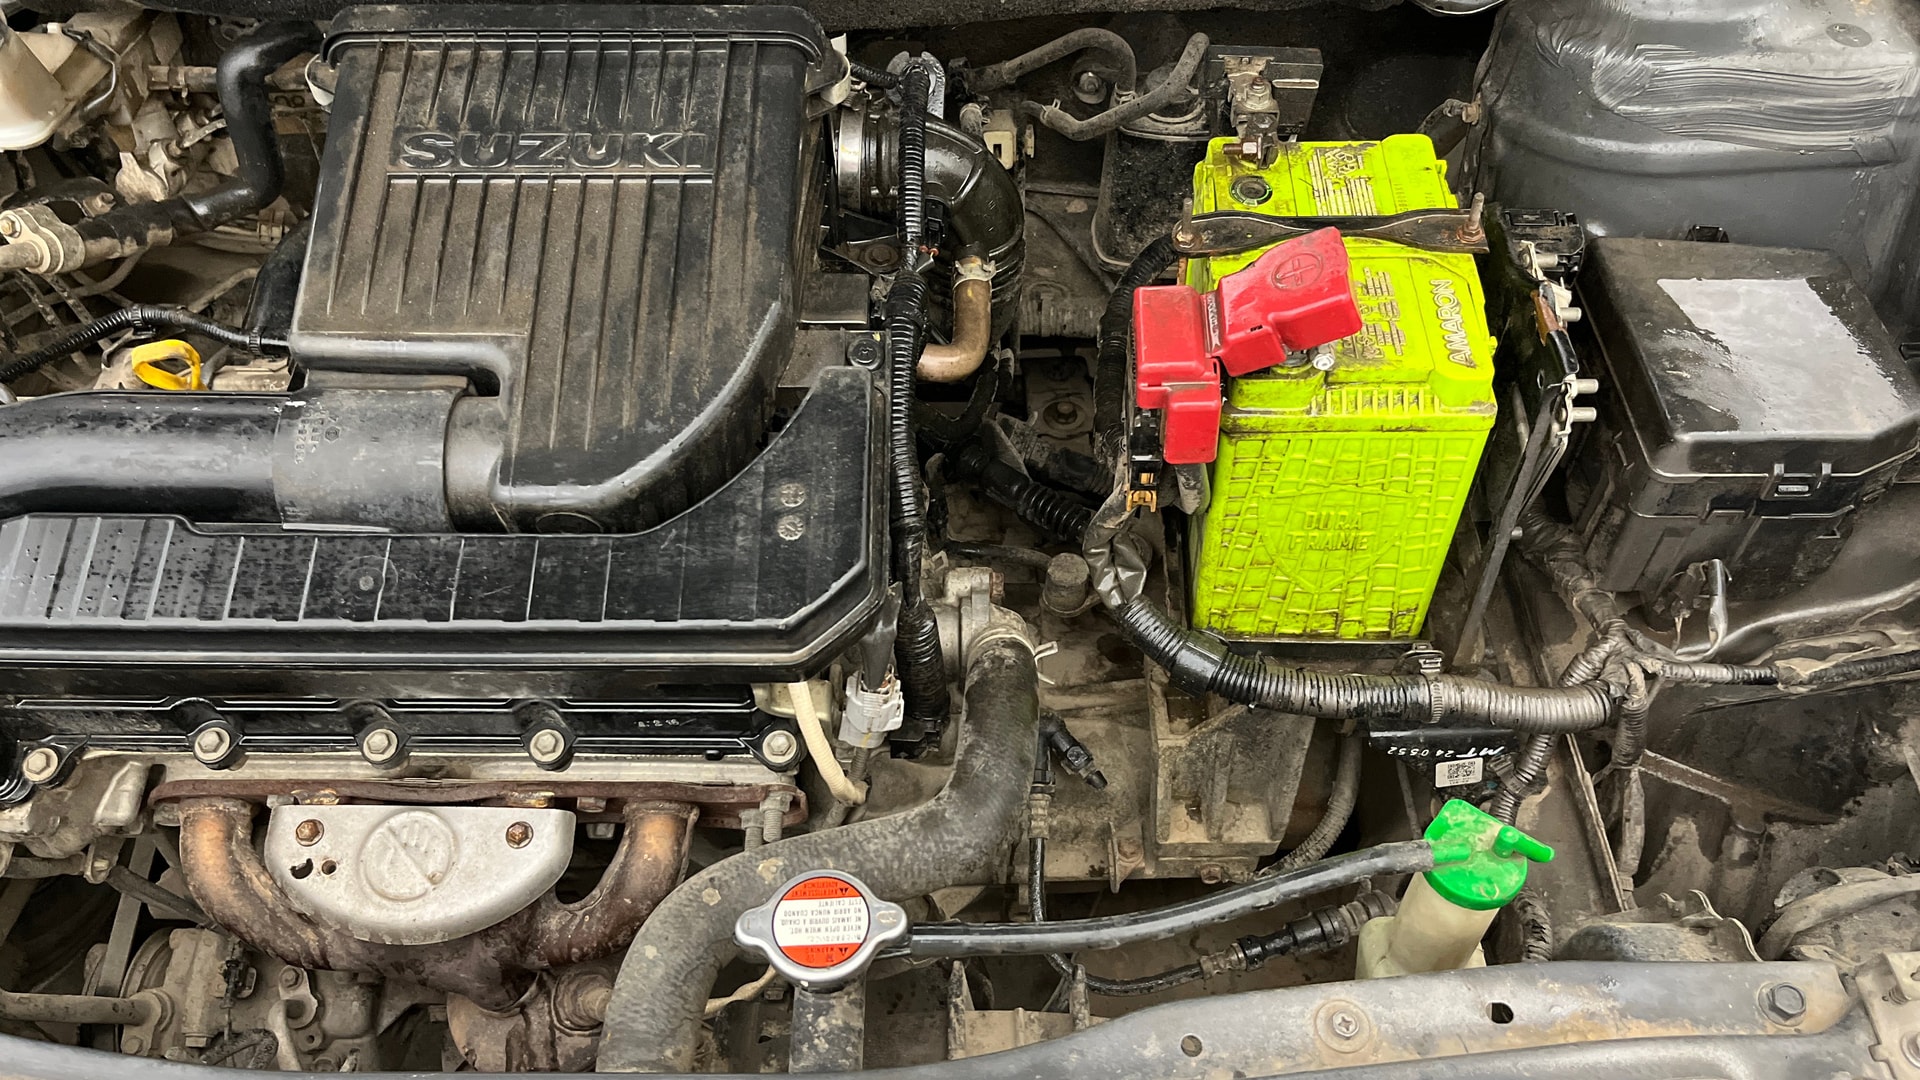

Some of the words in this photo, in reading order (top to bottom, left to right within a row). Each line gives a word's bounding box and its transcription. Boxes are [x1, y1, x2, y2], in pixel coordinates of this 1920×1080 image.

[400, 132, 707, 169] SUZUKI
[1430, 280, 1476, 367] AMARON
[1304, 511, 1361, 530] DURA
[1288, 532, 1369, 550] FRAME
[809, 917, 829, 925] OUVRIR
